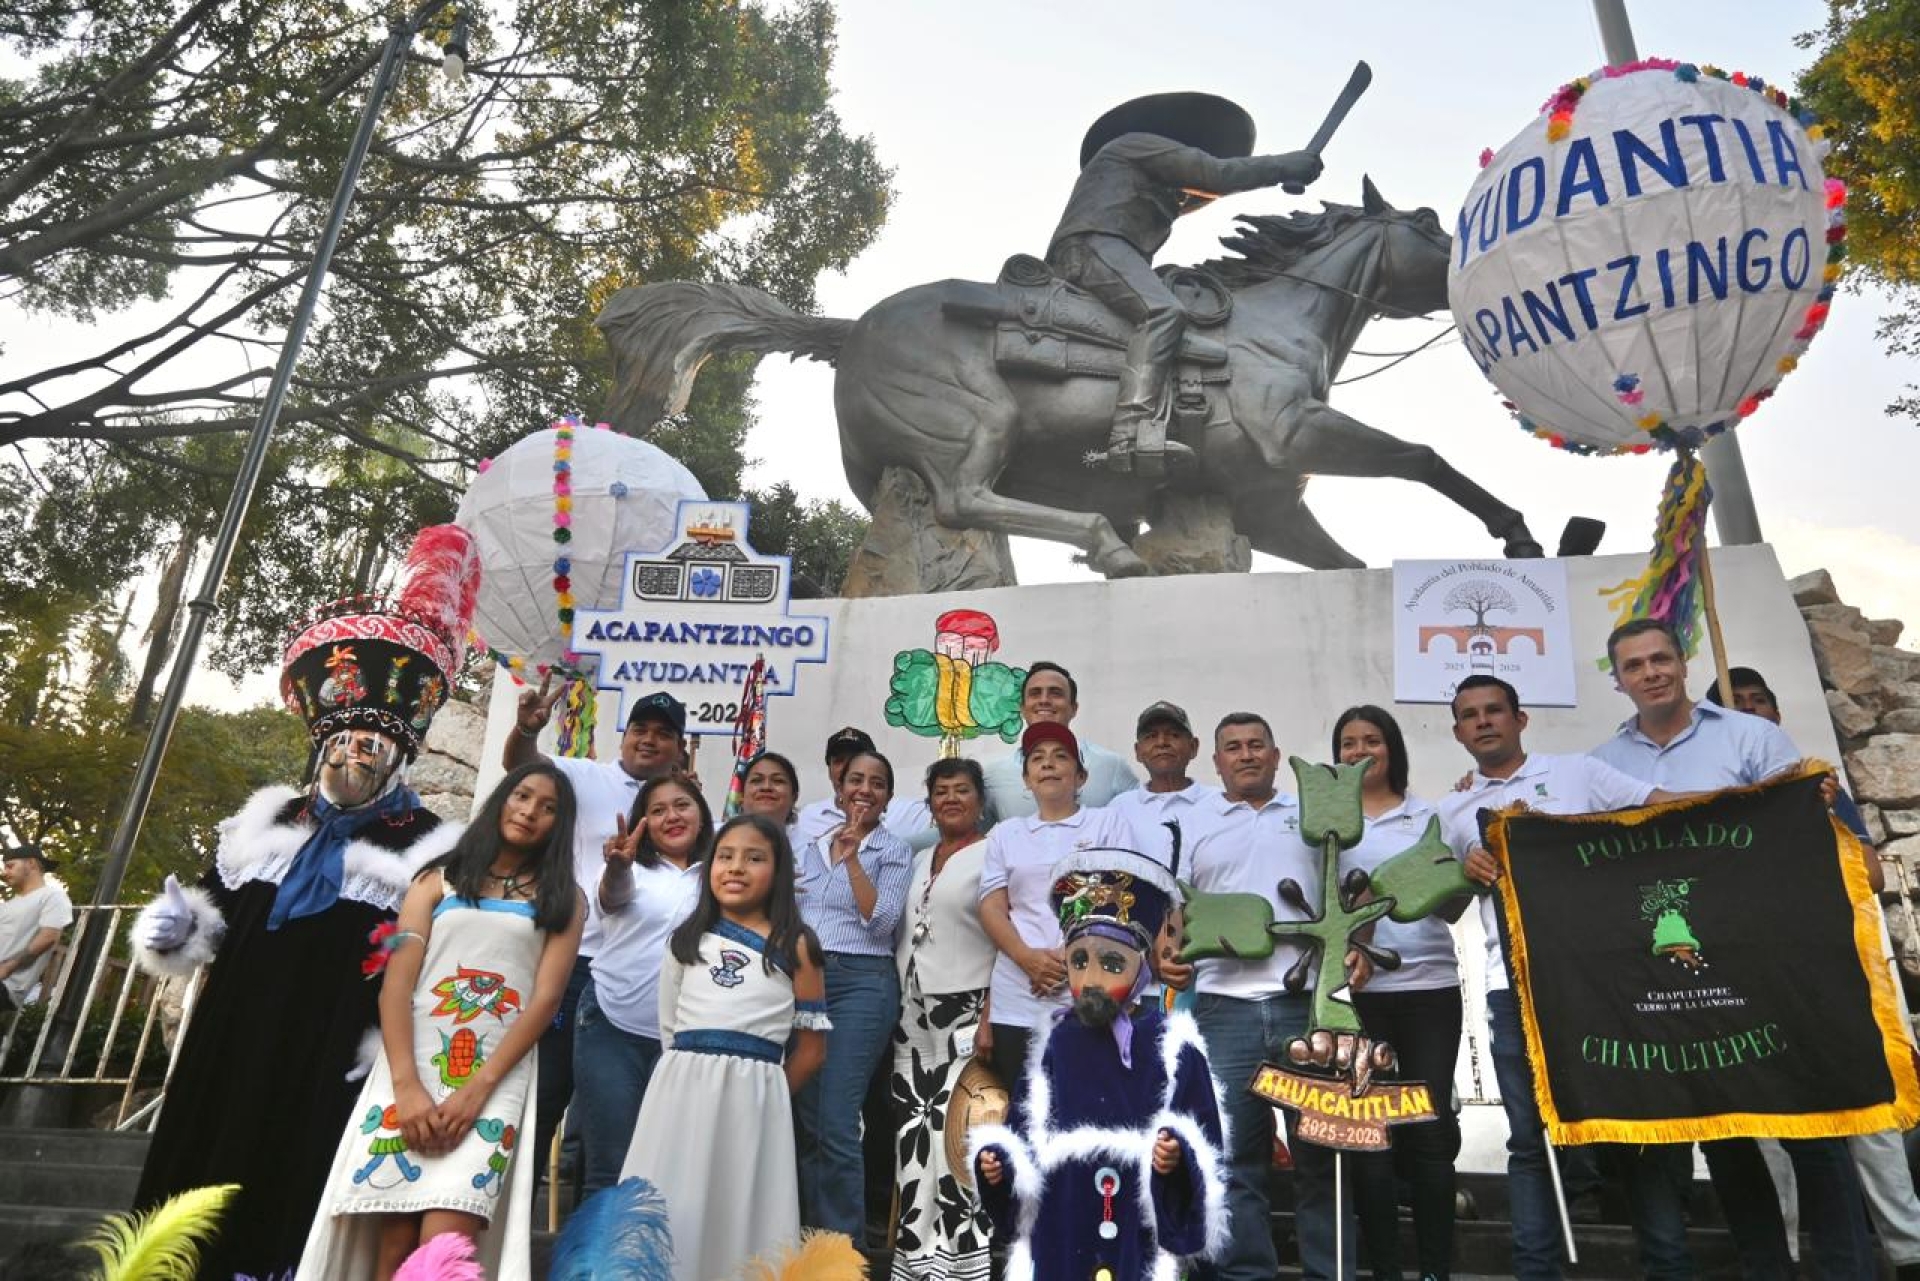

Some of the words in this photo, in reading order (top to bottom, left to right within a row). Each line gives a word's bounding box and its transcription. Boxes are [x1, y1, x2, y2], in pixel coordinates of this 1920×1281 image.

[585, 620, 814, 647] ACAPANTZINGO
[613, 661, 780, 685] AYUDANTA
[1577, 823, 1753, 867] POBLADO
[1299, 1117, 1381, 1144] 2025-2028
